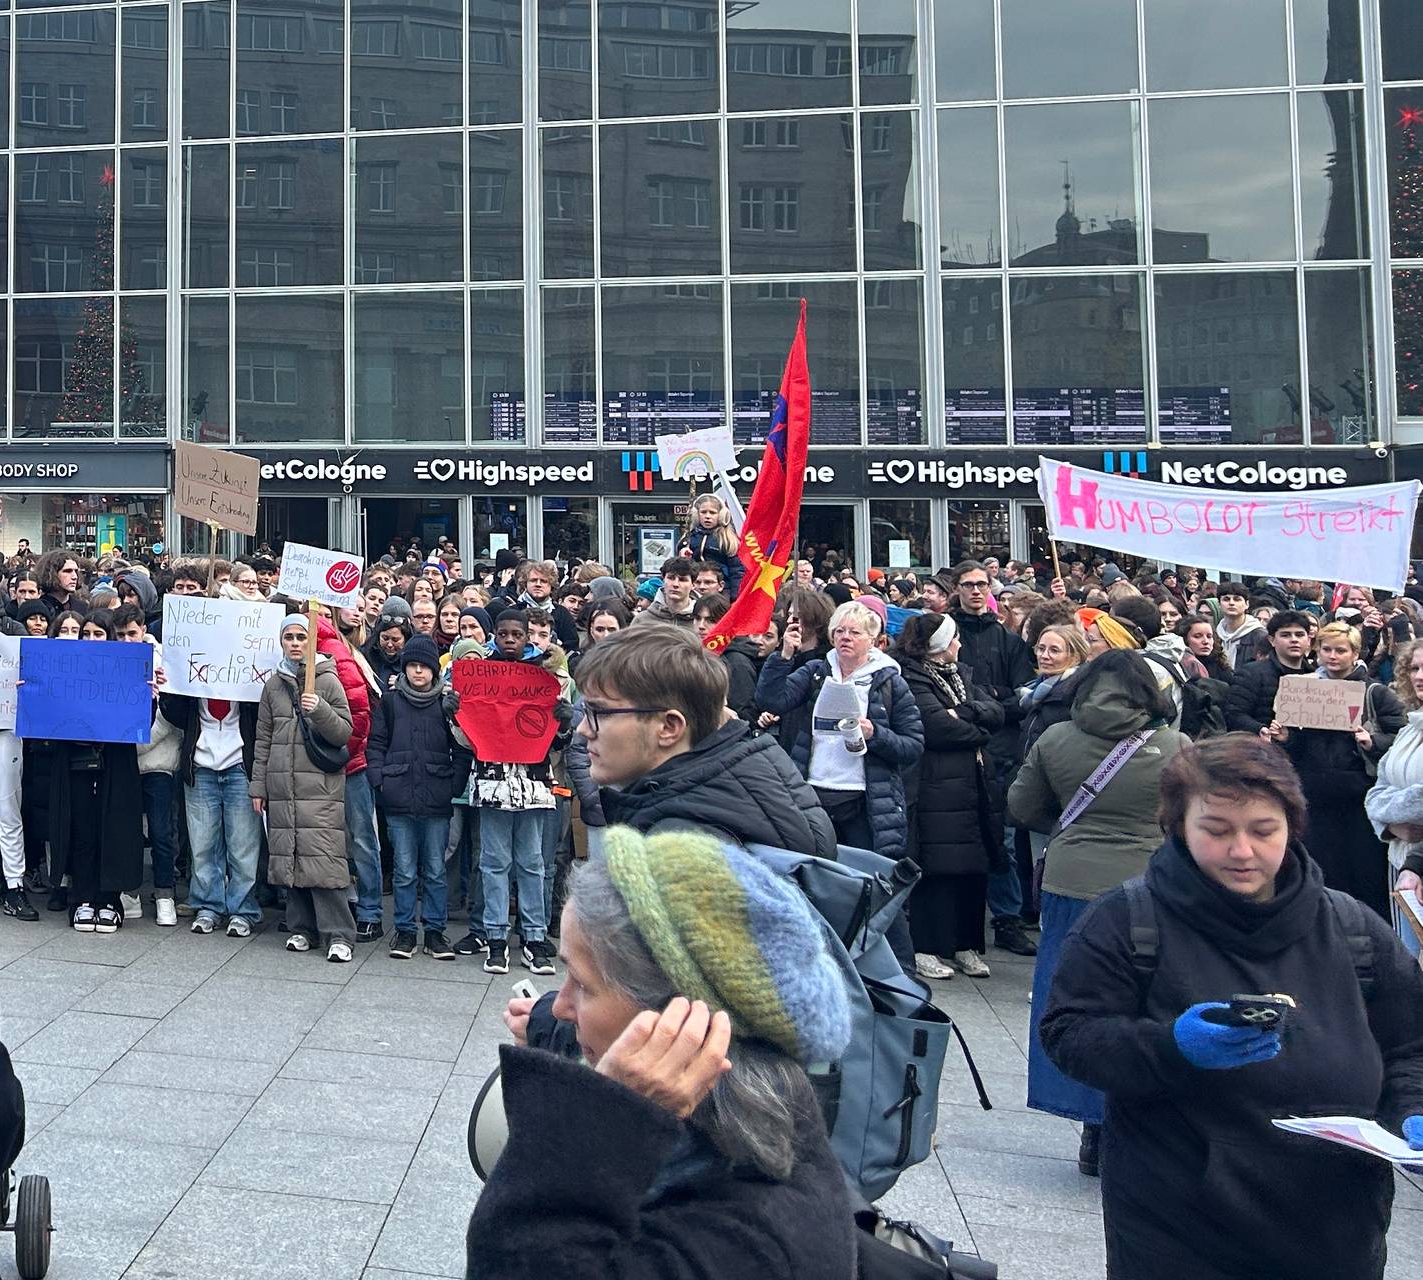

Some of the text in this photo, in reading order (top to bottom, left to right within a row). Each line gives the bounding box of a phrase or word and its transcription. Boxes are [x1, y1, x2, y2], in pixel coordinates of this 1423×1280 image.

[36, 463, 79, 478] SHOP
[261, 460, 386, 484] etCologne
[459, 460, 593, 486] Highspeed
[1161, 461, 1347, 490] NetCologne
[168, 600, 262, 628] Nieder mit
[168, 624, 190, 647] den
[462, 683, 500, 697] NEIN
